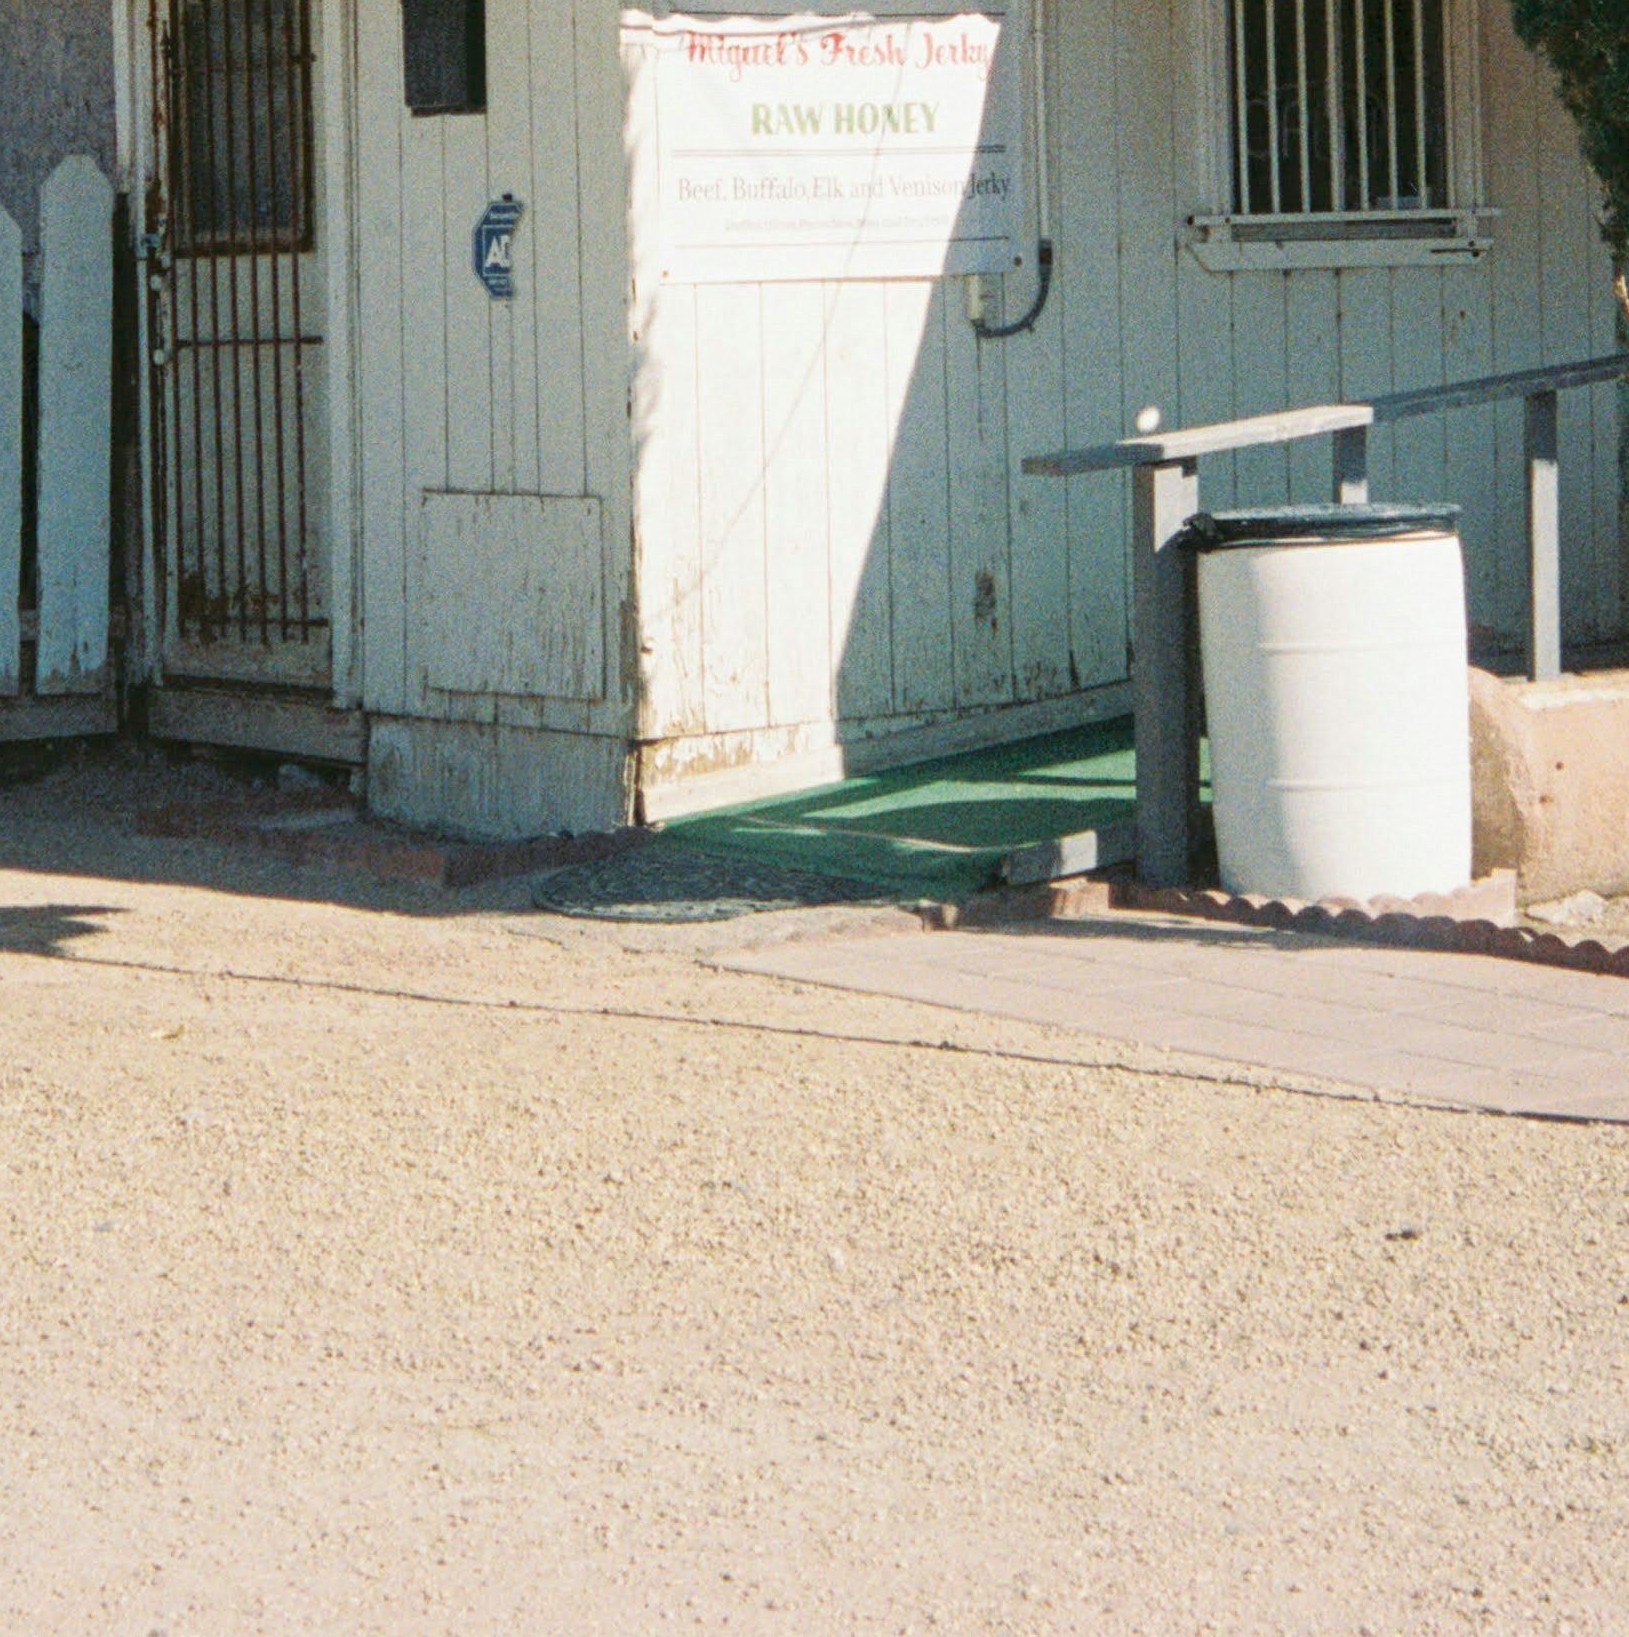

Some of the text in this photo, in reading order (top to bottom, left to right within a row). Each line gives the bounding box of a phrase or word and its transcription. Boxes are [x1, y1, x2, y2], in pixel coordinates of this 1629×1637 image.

[685, 30, 994, 82] Miguel's Fresh Jerky
[750, 101, 940, 136] RAW HONEY
[813, 176, 844, 200] Elk
[850, 175, 884, 199] and
[889, 174, 964, 199] Venison
[484, 234, 511, 268] AD
